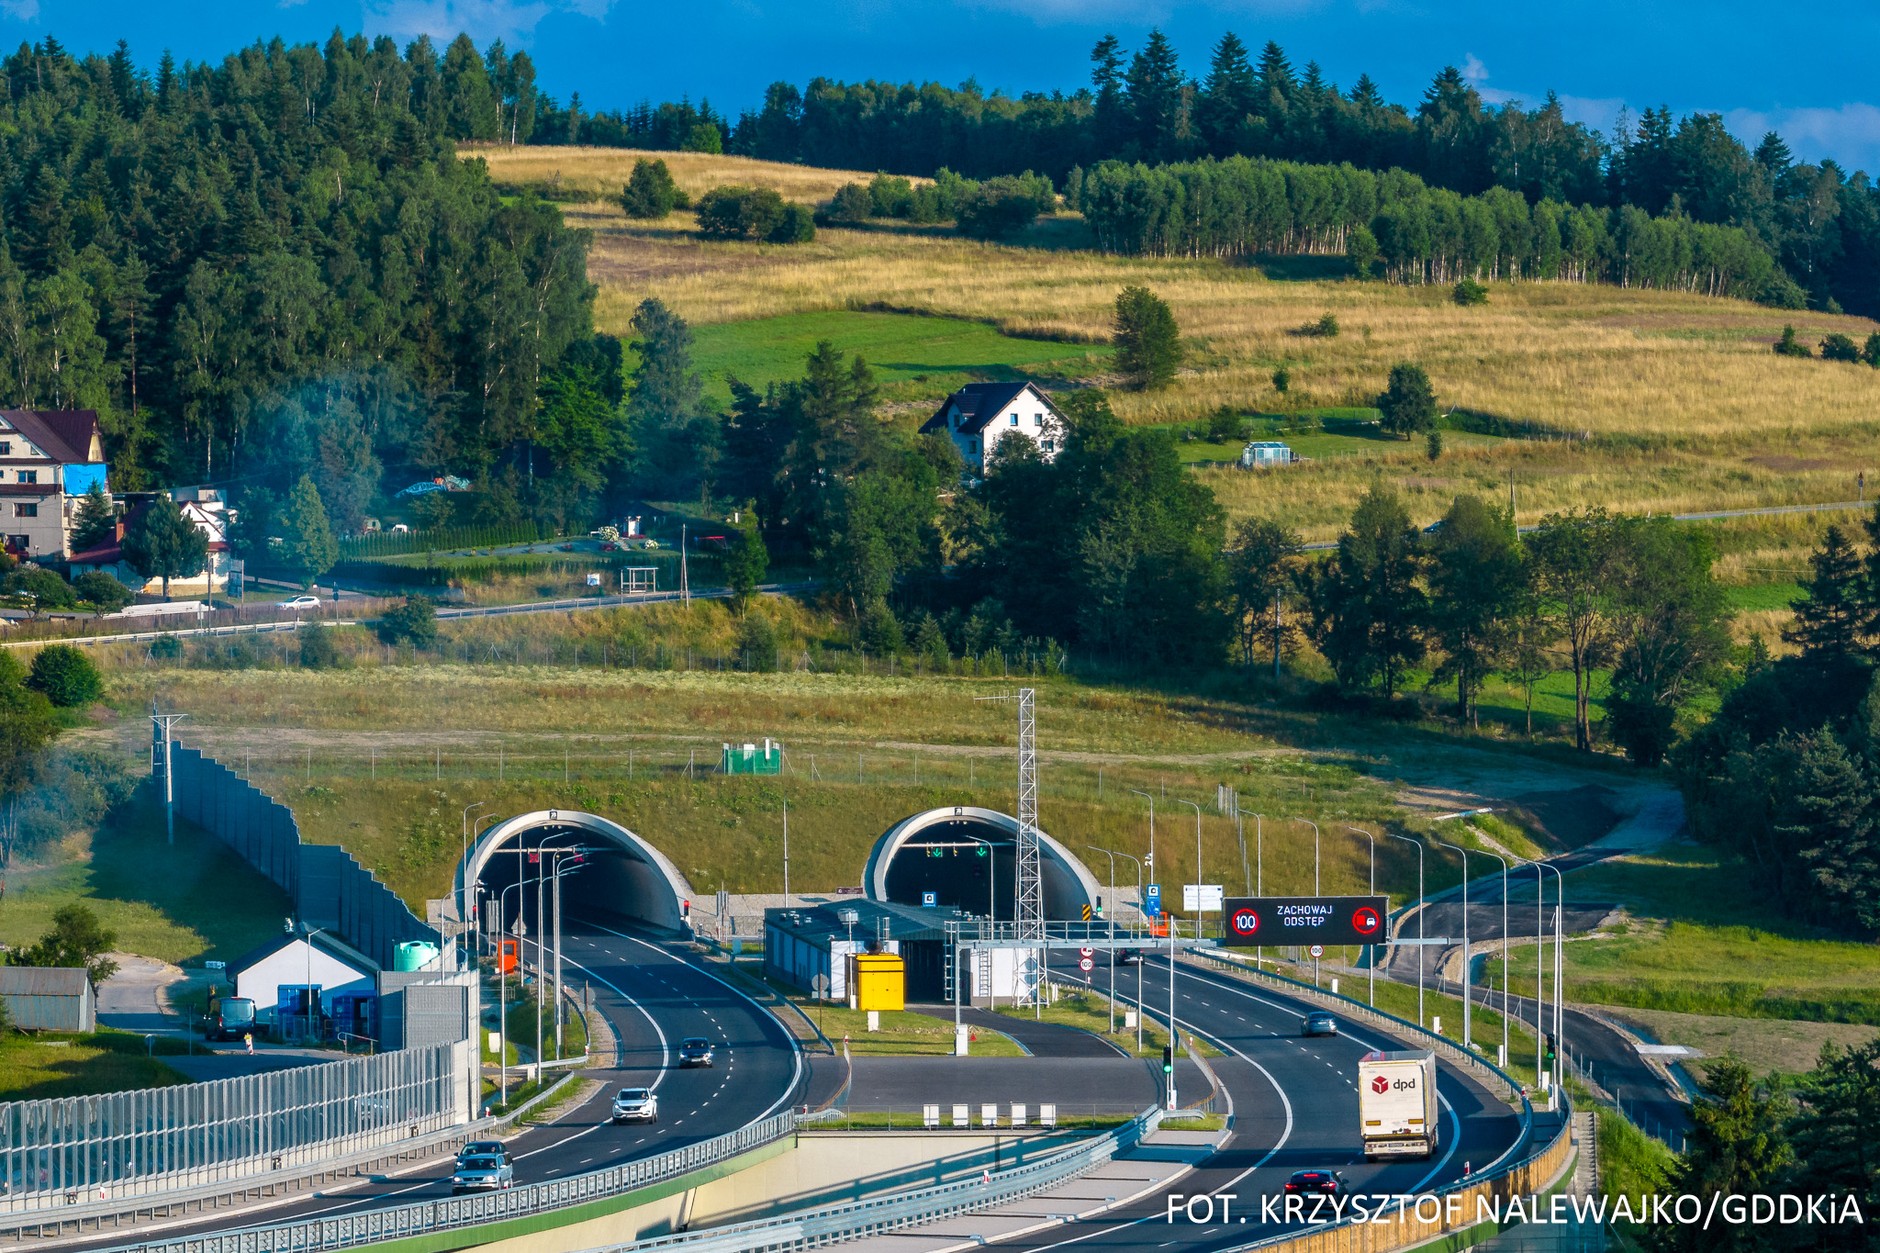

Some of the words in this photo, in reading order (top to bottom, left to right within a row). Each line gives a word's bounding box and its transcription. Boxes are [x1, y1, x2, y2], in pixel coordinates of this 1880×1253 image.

[1277, 905, 1333, 915] ZACHOWAJ
[1236, 915, 1256, 929] 100
[1284, 917, 1325, 927] ODSTĘP
[1393, 1078, 1415, 1091] dpd
